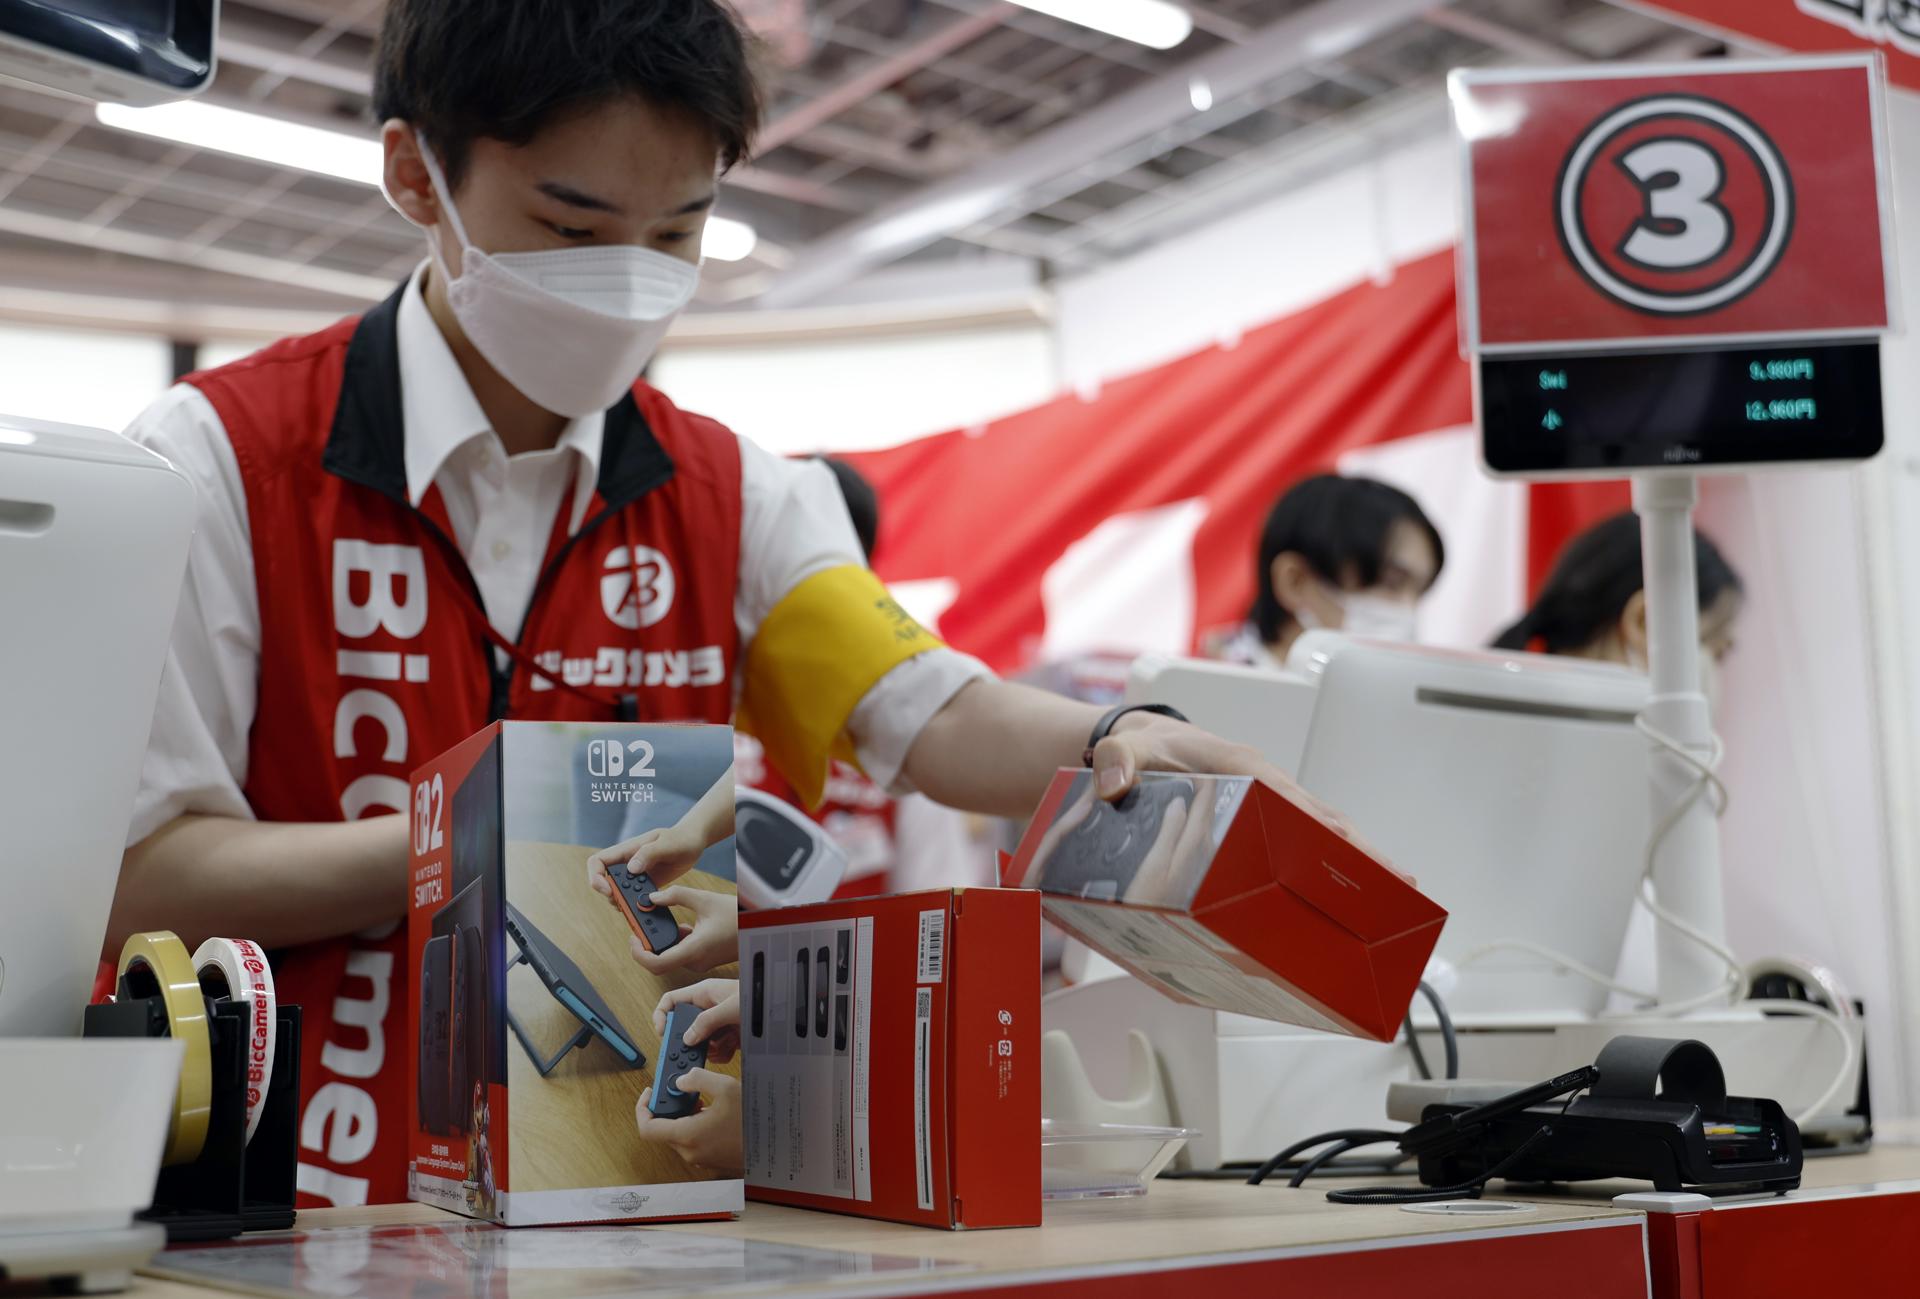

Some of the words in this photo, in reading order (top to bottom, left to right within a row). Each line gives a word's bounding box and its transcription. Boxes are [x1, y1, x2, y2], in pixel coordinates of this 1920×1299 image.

[1612, 135, 1734, 273] 3
[591, 791, 653, 802] SWITCH
[415, 861, 442, 882] NINTENDO
[415, 878, 442, 909] SWITCH
[248, 983, 267, 1083] BicCamera
